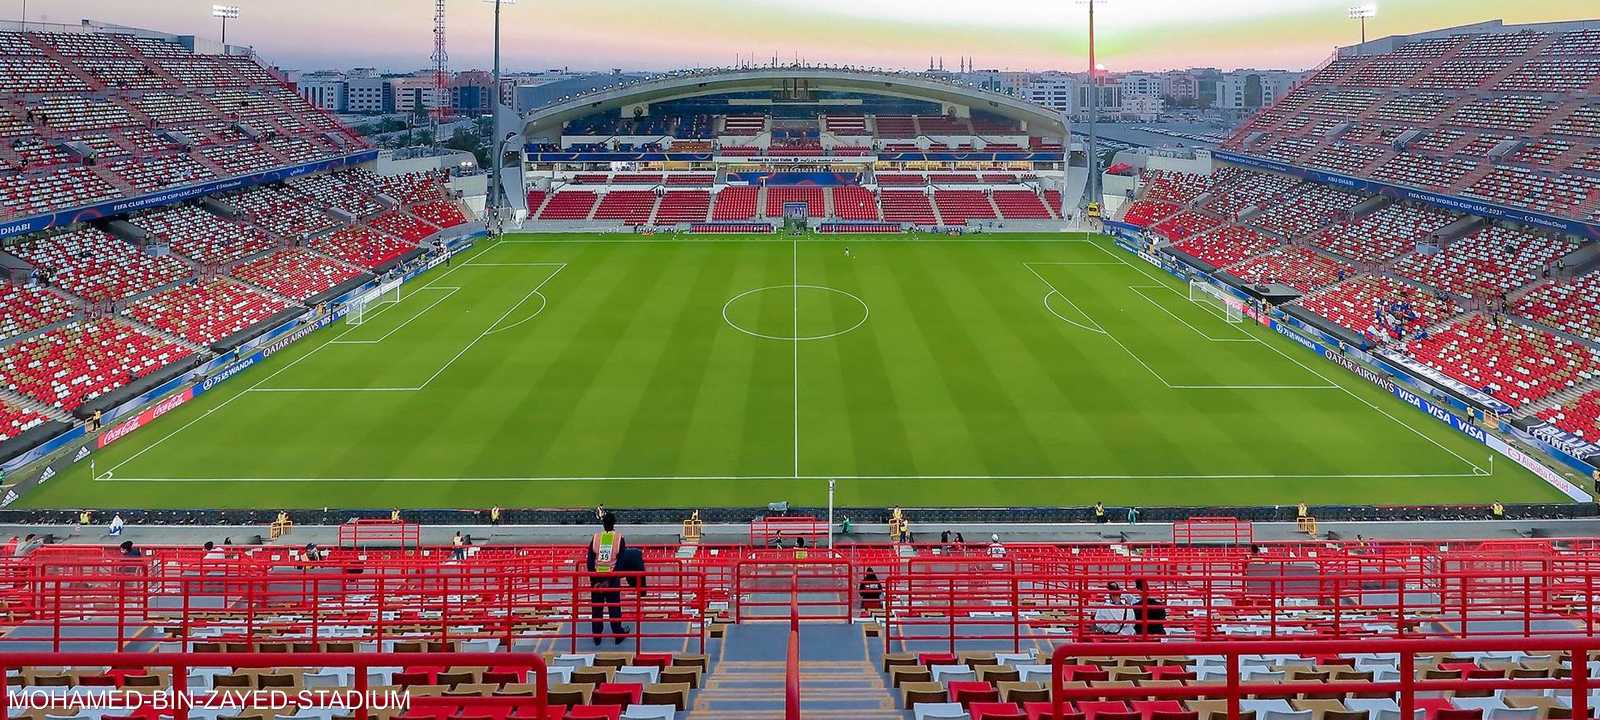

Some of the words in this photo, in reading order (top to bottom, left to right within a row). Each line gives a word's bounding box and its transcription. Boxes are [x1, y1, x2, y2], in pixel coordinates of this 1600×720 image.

[113, 203, 128, 211] FIFA
[128, 200, 144, 208] CLUB
[145, 195, 167, 204] WORLD
[1436, 198, 1458, 207] WORLD
[0, 223, 31, 235] DHABI
[263, 339, 289, 358] QATAR
[290, 321, 319, 343] AIRWAYS
[1295, 334, 1316, 350] WANDA
[228, 358, 254, 376] WANDA
[1325, 350, 1354, 371] QATAR
[1354, 366, 1395, 393] AIRWAYS
[153, 392, 186, 419] Coca-Cola
[1398, 387, 1421, 408] VISA
[1425, 403, 1451, 425] VISA
[104, 416, 141, 446] Coca-Cola
[1456, 418, 1485, 442] VISA
[1549, 473, 1569, 493] Cloud
